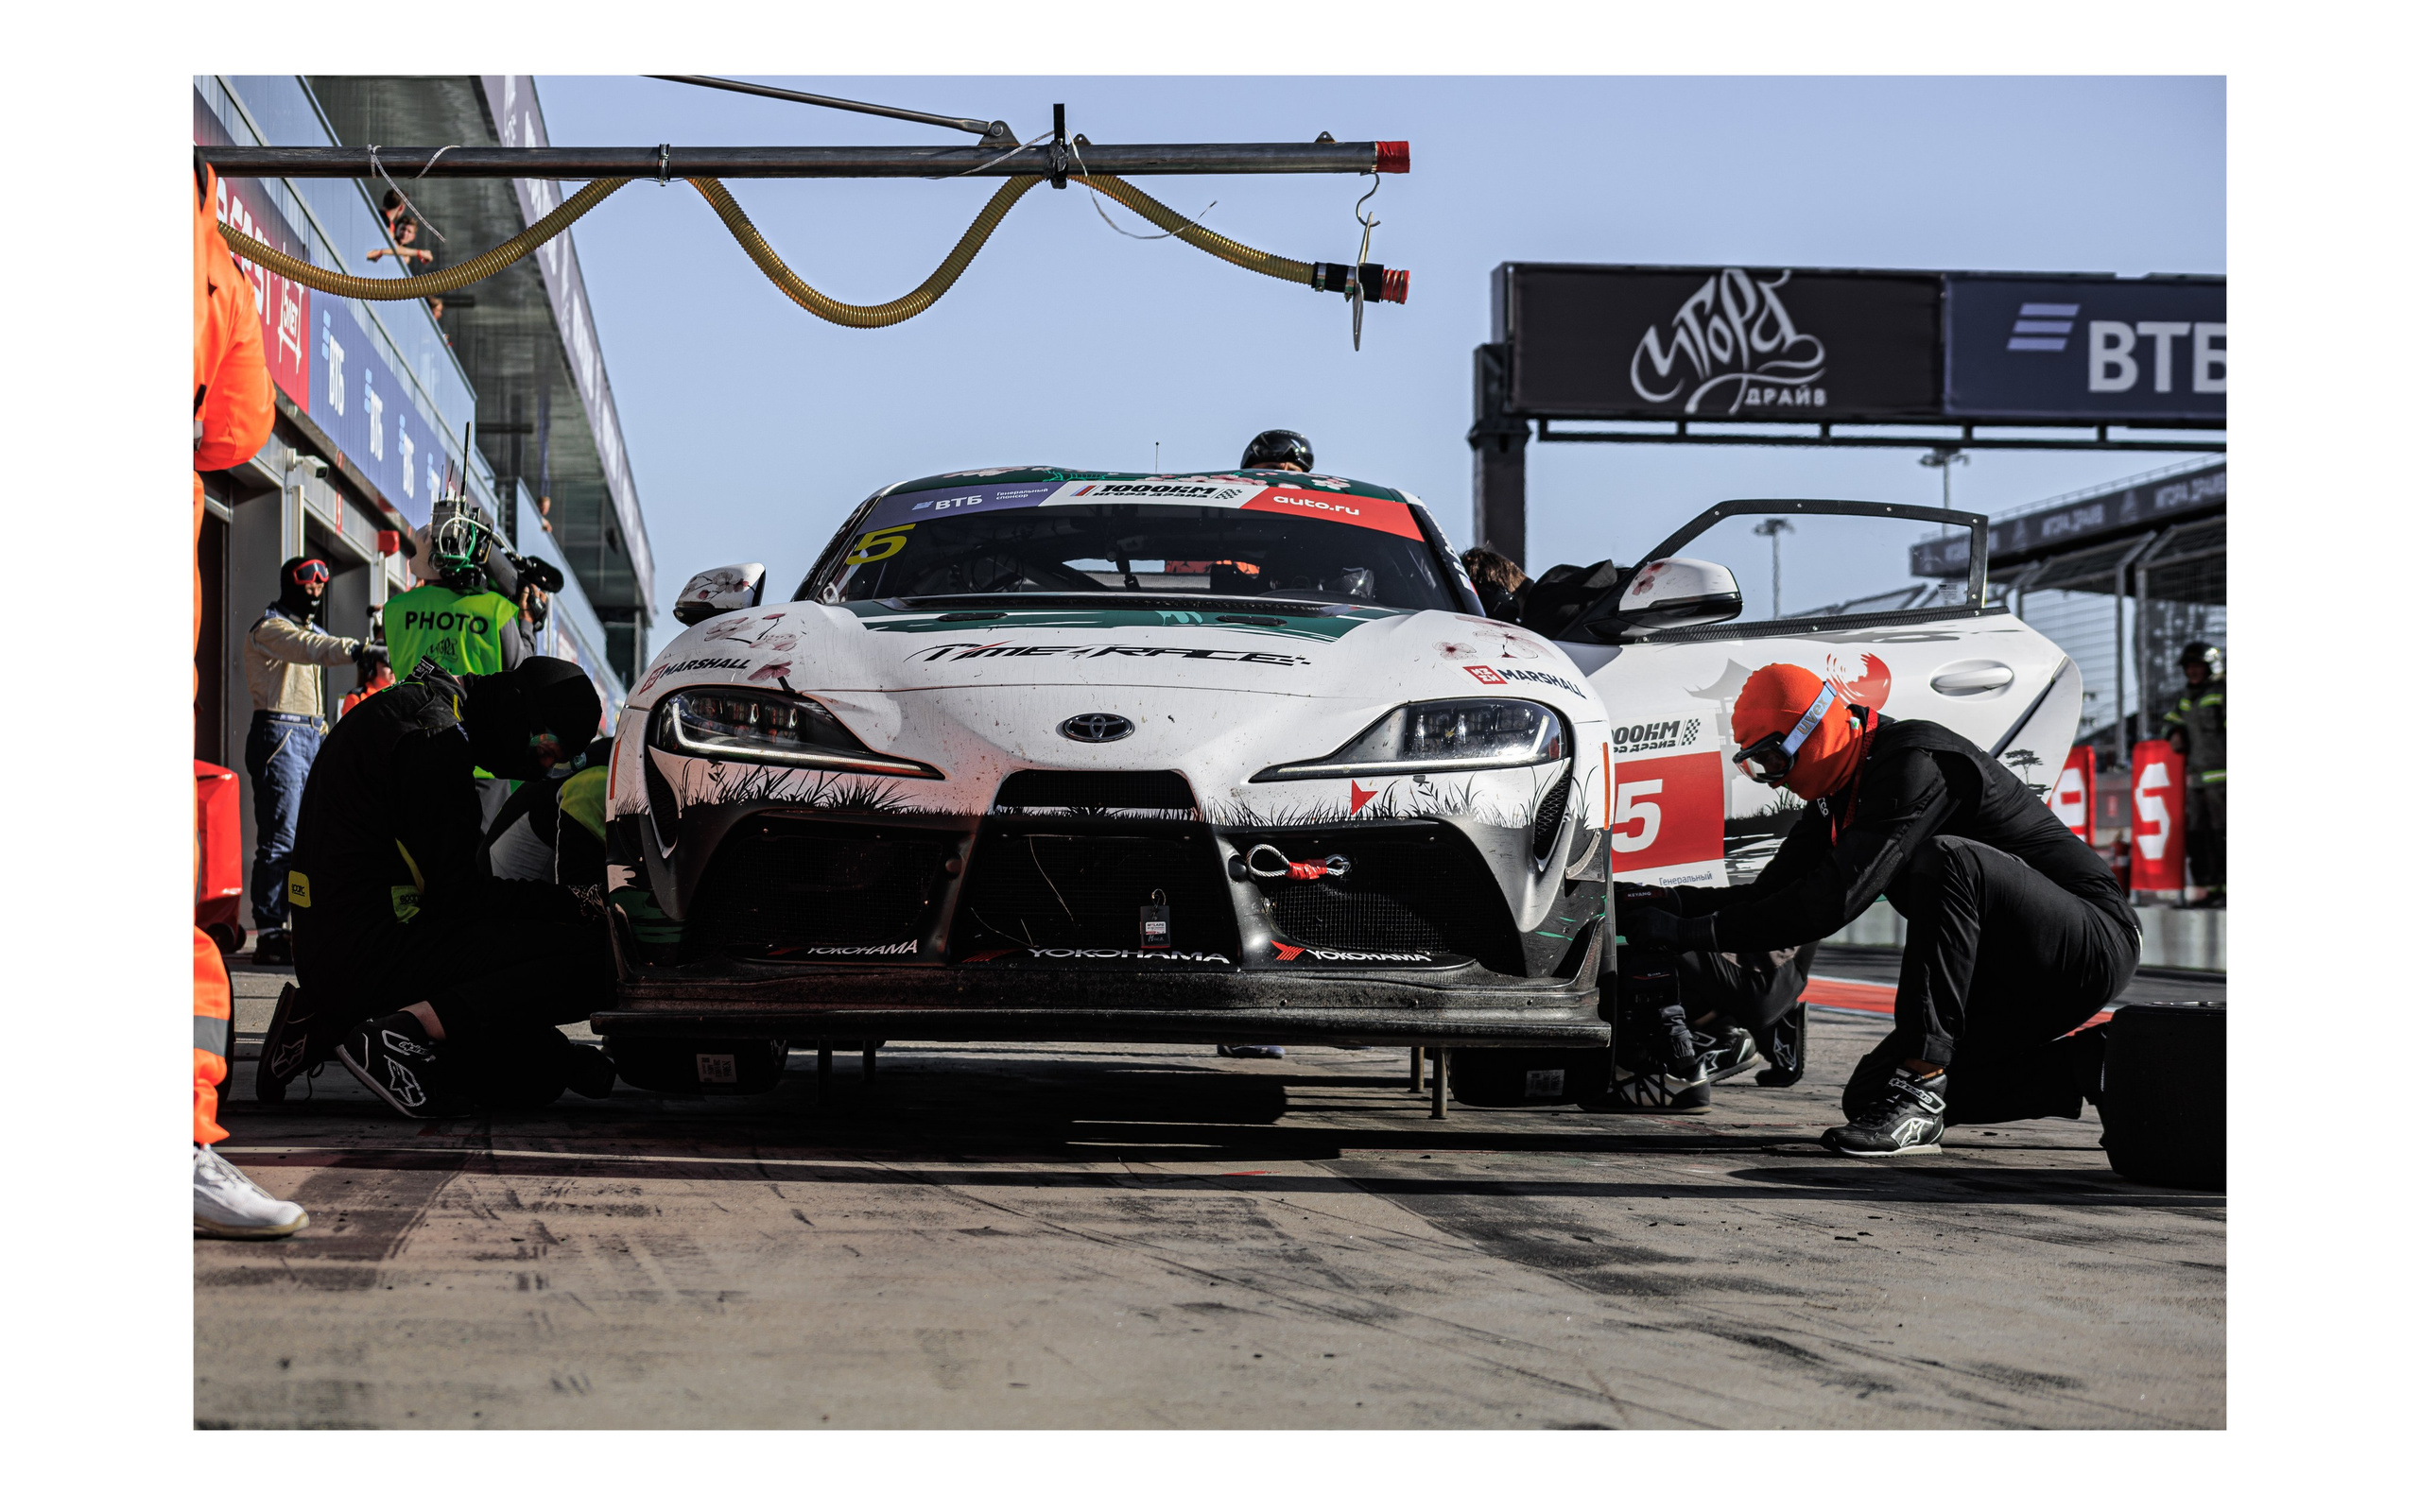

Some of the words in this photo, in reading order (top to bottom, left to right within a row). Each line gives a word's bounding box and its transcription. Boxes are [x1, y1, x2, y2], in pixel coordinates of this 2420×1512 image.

[2088, 319, 2227, 393] ВТБ
[1744, 385, 1827, 407] ДРАЙВ
[935, 494, 983, 511] ВТБ
[1272, 495, 1360, 516] auto.ru
[845, 523, 917, 566] 5
[405, 610, 489, 635] PHOTO
[659, 658, 752, 679] MARSHALL
[1496, 669, 1588, 701] MARSHALL
[1796, 696, 1829, 736] uvex
[1611, 720, 1681, 746] 00КМ
[1611, 778, 1663, 853] 5
[1658, 870, 1713, 887] Генеральный
[807, 938, 919, 955] YOKOHAMA
[1028, 948, 1231, 965] YOKOHAMA
[1305, 948, 1432, 963] YOKOHAMA
